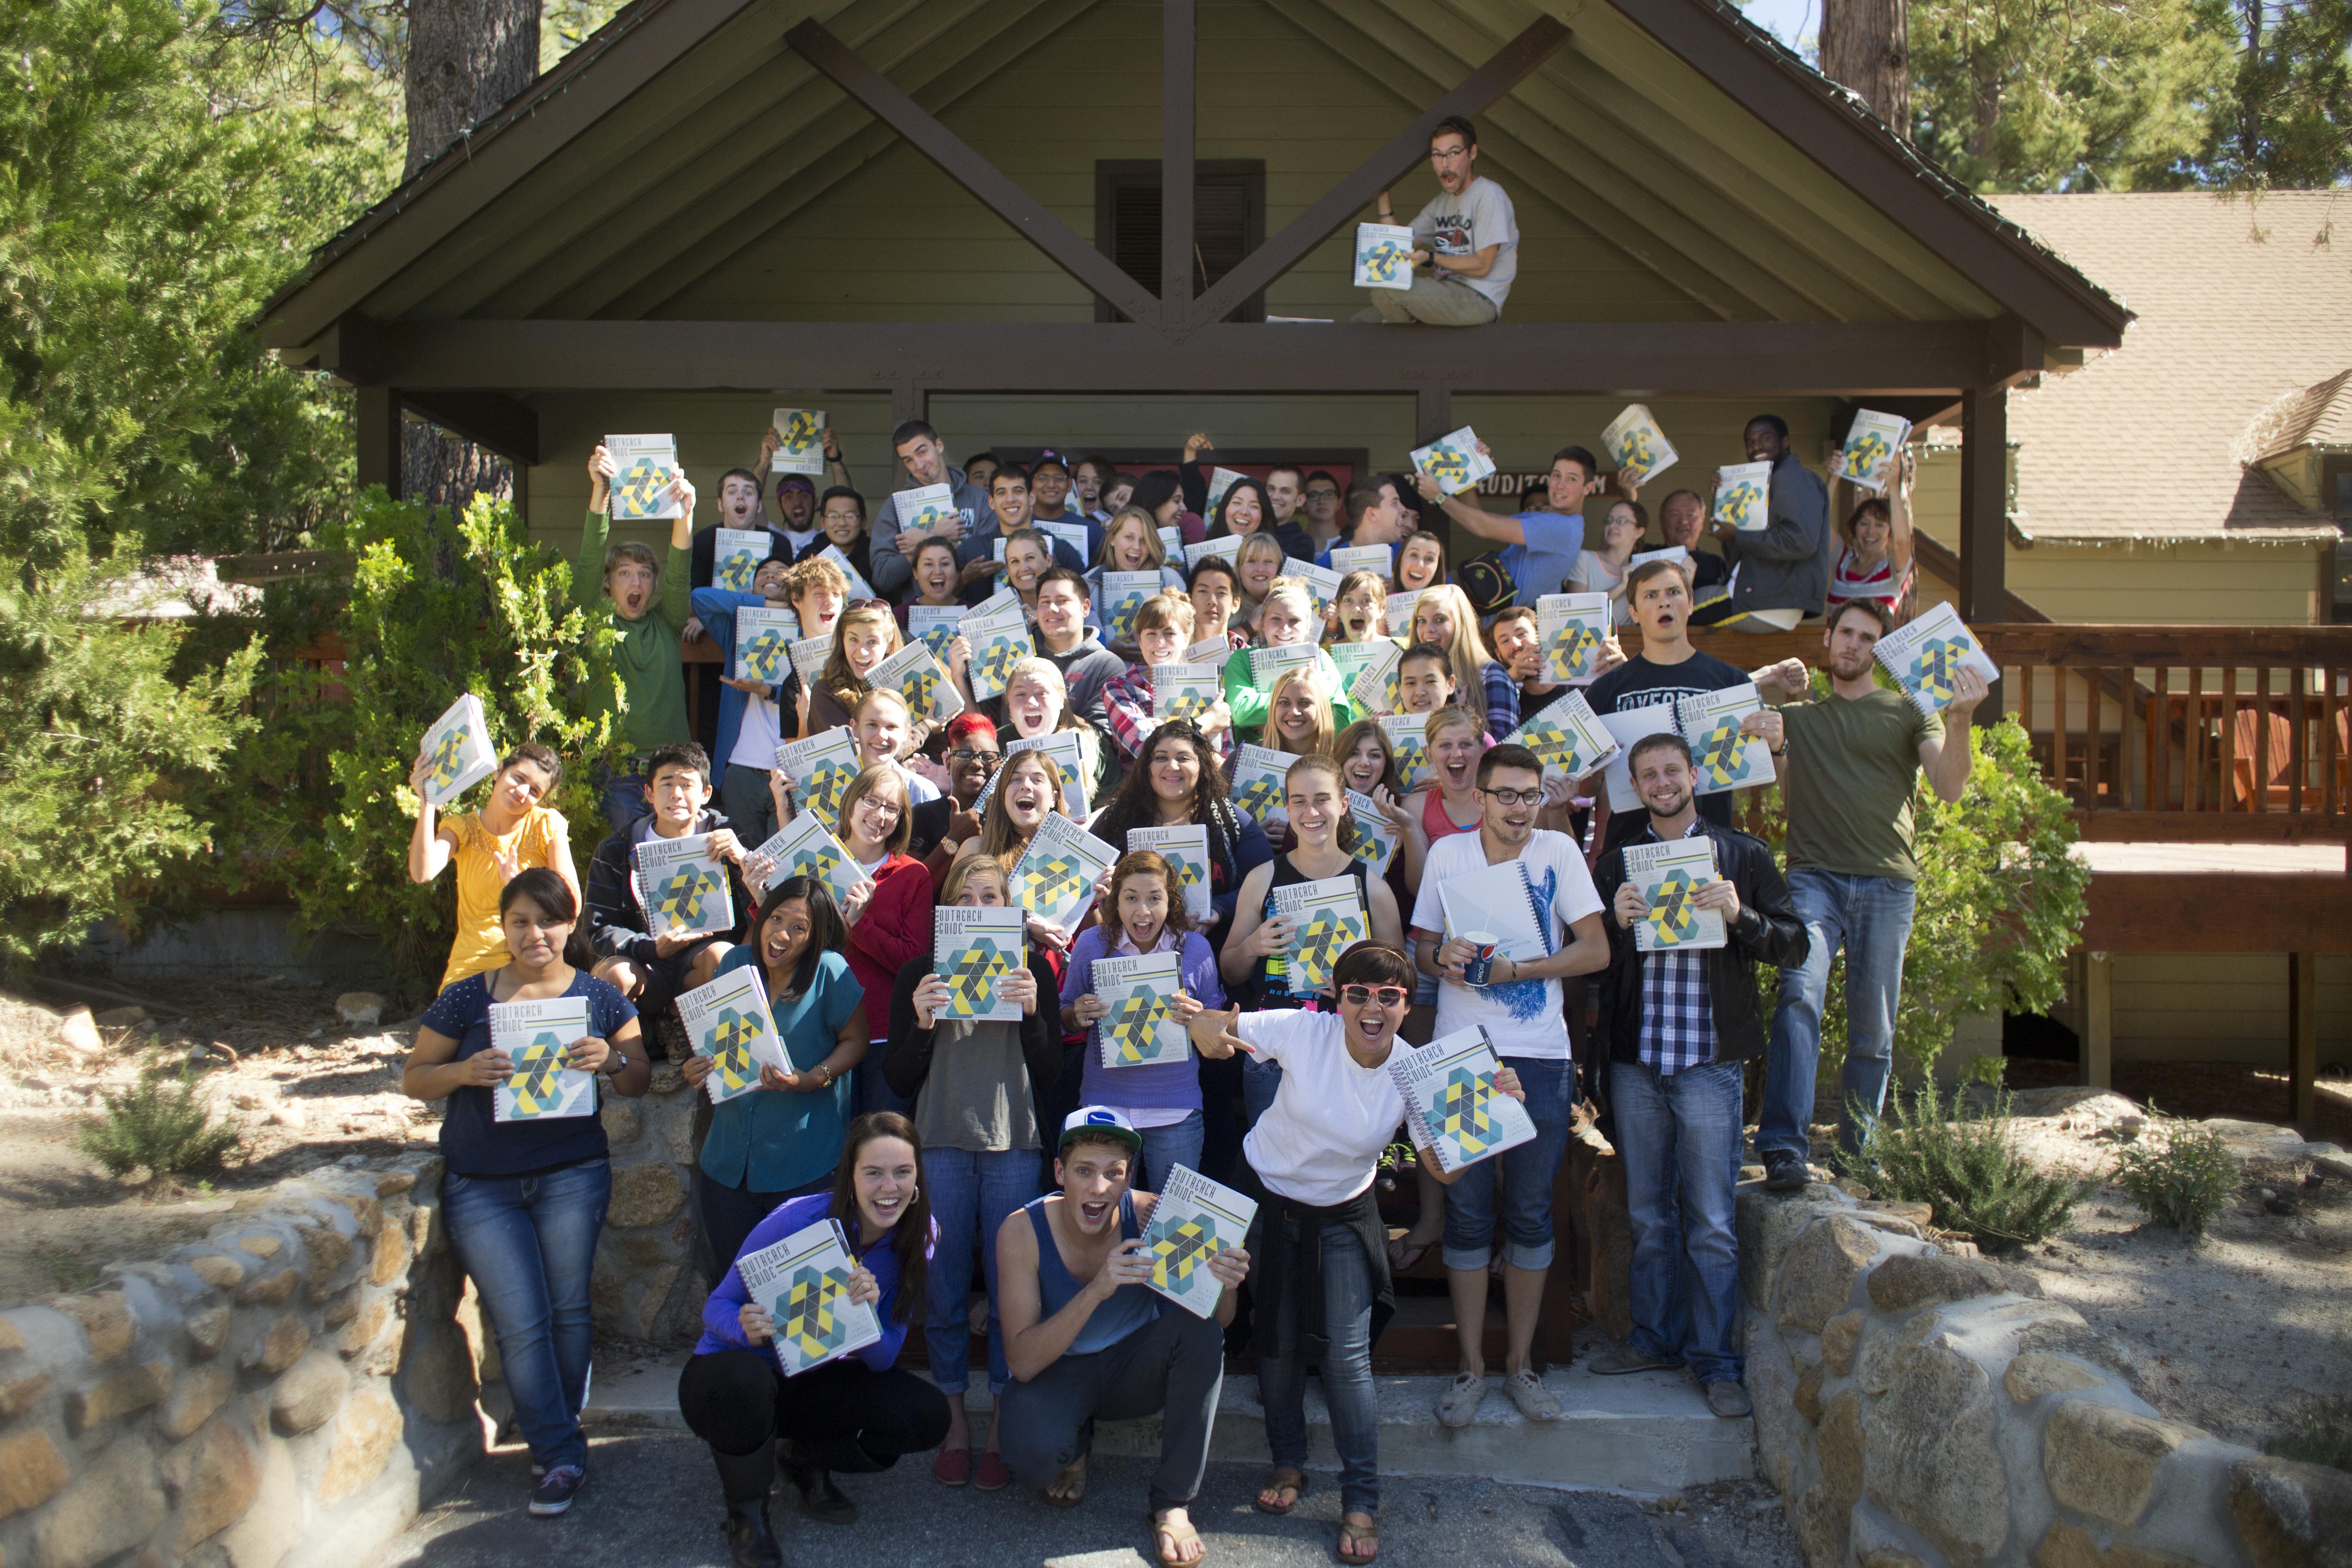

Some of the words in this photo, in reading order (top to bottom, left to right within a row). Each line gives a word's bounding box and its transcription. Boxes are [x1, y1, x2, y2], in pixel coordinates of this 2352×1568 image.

[608, 438, 642, 448] OUTREACH
[610, 448, 628, 456] GUIDE
[1188, 543, 1216, 554] OUTREACH
[1333, 549, 1361, 558] OUTREACH
[1289, 560, 1315, 574] OUTREACH
[1106, 574, 1134, 582] OUTREACH
[1106, 582, 1122, 591] GUIDE
[1387, 604, 1404, 613] GUIDE
[1539, 599, 1571, 609] OUTREACH
[740, 609, 770, 618] OUTREACH
[1540, 609, 1557, 619] GUIDE
[962, 618, 995, 629] OUTREACH
[965, 630, 983, 640] GUIDE
[1881, 625, 1918, 651] OUTREACH
[793, 640, 824, 652] OUTREACH
[1335, 645, 1364, 654] OUTREACH
[1887, 642, 1908, 659] GUIDE
[795, 652, 815, 663] GUIDE
[1256, 649, 1287, 661] OUTREACH
[1335, 654, 1352, 663] GUIDE
[869, 659, 899, 683] OUTREACH
[1156, 667, 1187, 675] OUTREACH
[1258, 660, 1275, 670] GUIDE
[1156, 677, 1174, 686] GUIDE
[1353, 666, 1377, 695] OUTREACH
[1362, 682, 1376, 700] GUIDE
[1559, 697, 1574, 717] GUIDE
[1568, 692, 1592, 722] OUTREACH
[1681, 694, 1720, 710] OUTREACH
[1381, 717, 1409, 726] OUTREACH
[1684, 710, 1706, 723] GUIDE
[780, 739, 815, 758] OUTREACH
[1010, 740, 1044, 753] OUTREACH
[1243, 746, 1274, 762] OUTREACH
[783, 755, 804, 769] GUIDE
[1242, 756, 1259, 768] GUIDE
[1347, 791, 1370, 809] TREACH
[1043, 827, 1065, 844] GUIDE
[1049, 816, 1085, 844] OUTREACH
[1133, 830, 1169, 842] OUTREACH
[643, 842, 682, 857] OUTREACH
[1629, 845, 1670, 860] OUTREACH
[645, 855, 667, 868] GUIDE
[1631, 860, 1654, 873] GUIDE
[1278, 884, 1318, 901] OUTREACH
[1280, 899, 1302, 913] GUIDE
[940, 910, 982, 922] OUTREACH
[940, 923, 962, 934] GUIDE
[1097, 960, 1137, 974] OUTREACH
[1098, 974, 1121, 987] GUIDE
[680, 985, 717, 1010] OUTREACH
[496, 1004, 542, 1019] OUTREACH
[684, 1004, 706, 1023] GUIDE
[497, 1020, 522, 1032] GUIDE
[1400, 1044, 1444, 1071] OUTREACH
[1406, 1065, 1432, 1084] GUIDE
[1175, 1169, 1216, 1198] OUTREACH
[1169, 1182, 1194, 1202] GUIDE
[743, 1243, 790, 1275] OUTREACH
[749, 1266, 776, 1289] GUIDE
